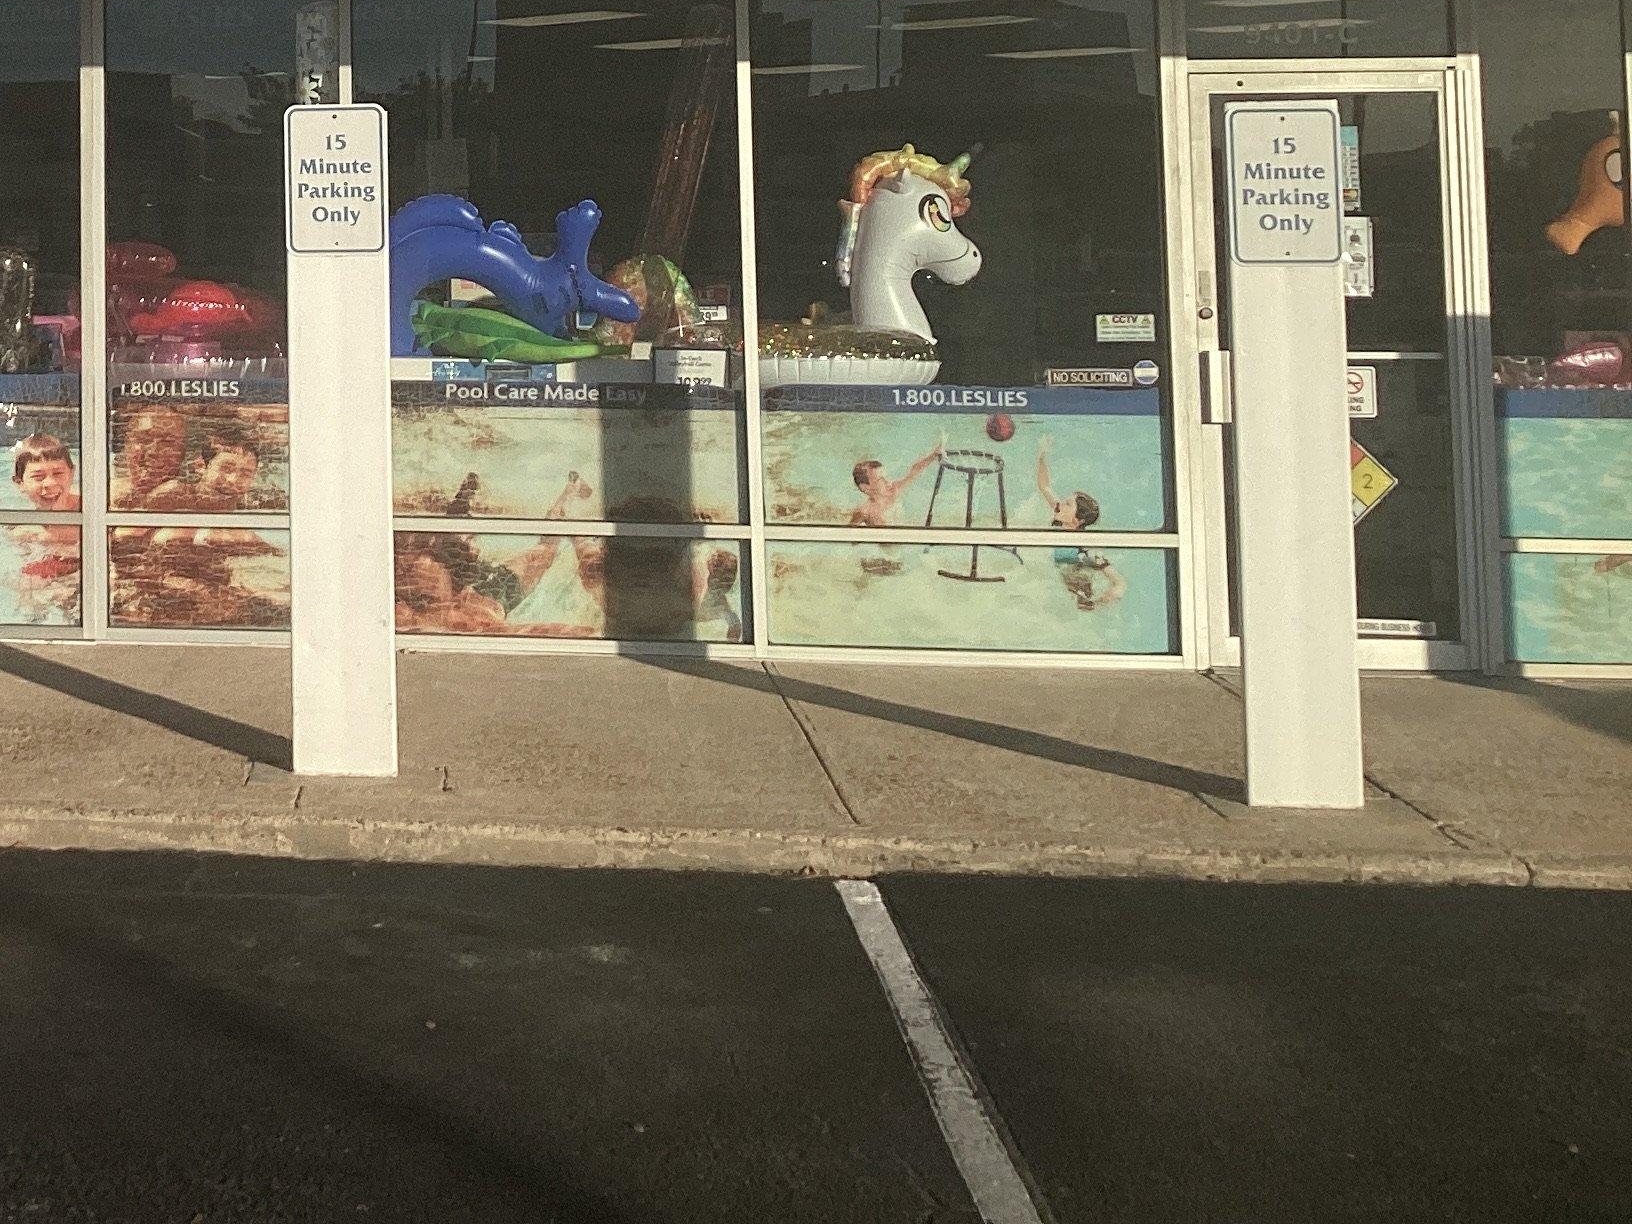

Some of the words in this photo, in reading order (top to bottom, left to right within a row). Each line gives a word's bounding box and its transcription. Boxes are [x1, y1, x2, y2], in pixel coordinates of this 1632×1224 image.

[325, 134, 347, 150] 15
[1272, 137, 1297, 155] 15
[299, 158, 373, 175] Minute
[1243, 162, 1326, 180] Minute
[297, 181, 376, 202] Parking
[1242, 188, 1331, 210] Parking
[312, 206, 361, 226] Only
[1259, 213, 1315, 236] Only
[1112, 315, 1138, 324] CCTV
[1053, 372, 1069, 383] NO
[1071, 372, 1128, 383] SOLICITING
[445, 383, 489, 400] Pool
[494, 383, 539, 400] Care
[544, 383, 600, 401] Made
[605, 385, 647, 406] Easy
[892, 389, 1029, 407] 1.800.LESLIES
[1362, 473, 1374, 490] 2
